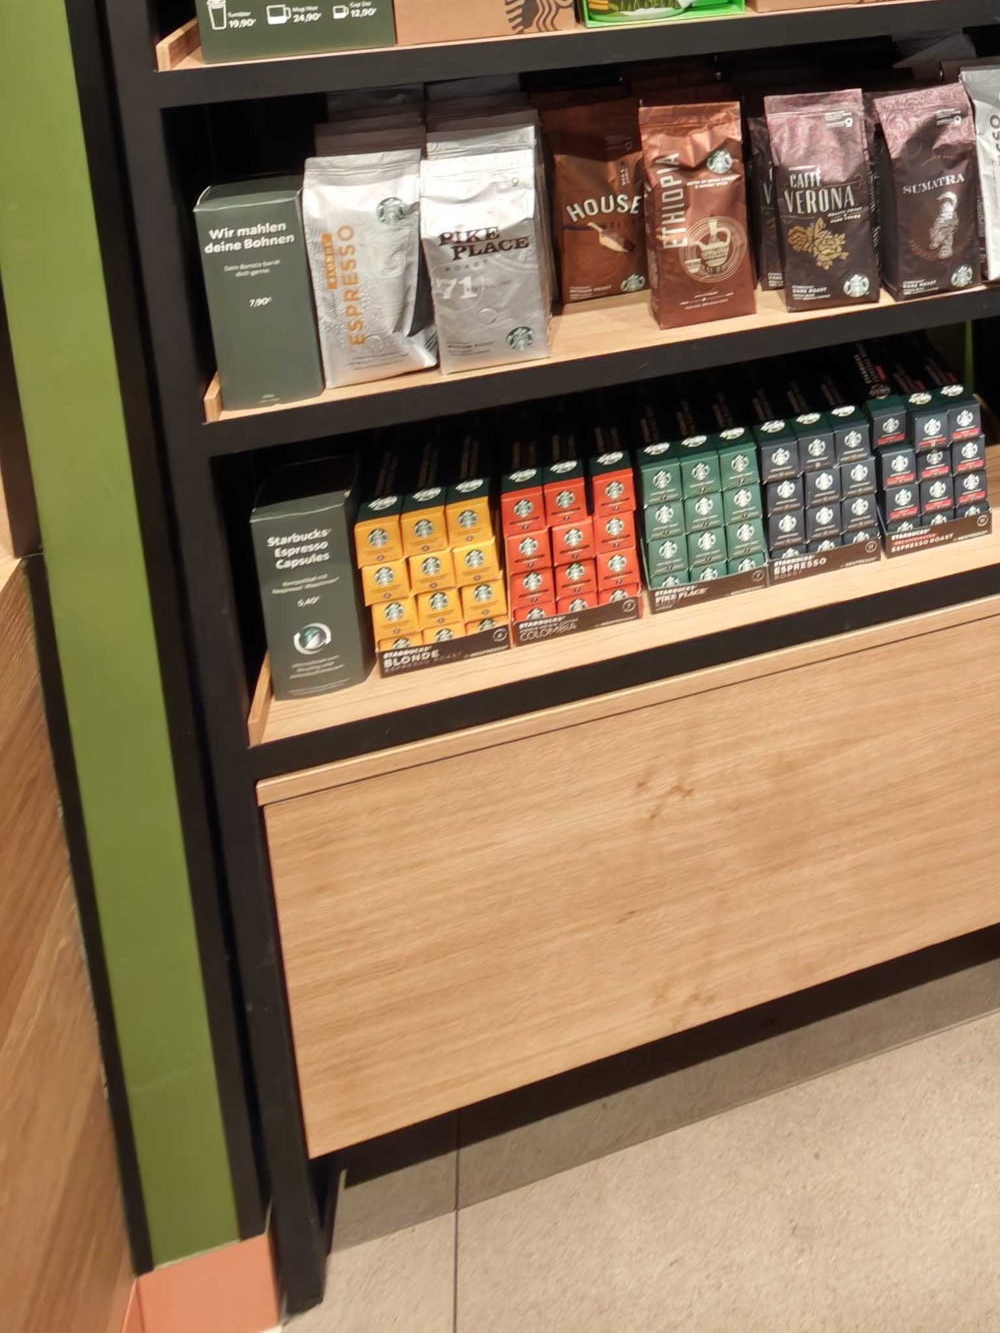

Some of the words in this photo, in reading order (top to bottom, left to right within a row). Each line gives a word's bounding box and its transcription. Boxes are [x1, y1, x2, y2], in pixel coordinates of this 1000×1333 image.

[902, 172, 965, 194] SUMATRA
[566, 194, 642, 222] HOUSE
[655, 153, 688, 249] ETHIOPIA
[784, 185, 855, 214] VERONA
[209, 227, 235, 240] Wir
[237, 222, 286, 237] mahlen
[439, 227, 500, 247] PIKE
[204, 241, 242, 254] deine
[244, 234, 295, 249] Bohnen
[451, 236, 530, 261] PLACE
[337, 225, 365, 346] ESPRESSO
[267, 528, 329, 547] Starbucks
[274, 541, 328, 558] Espresso
[276, 552, 330, 570] Capsules
[774, 557, 827, 575] ESPRESSO
[383, 649, 440, 668] BLONDE
